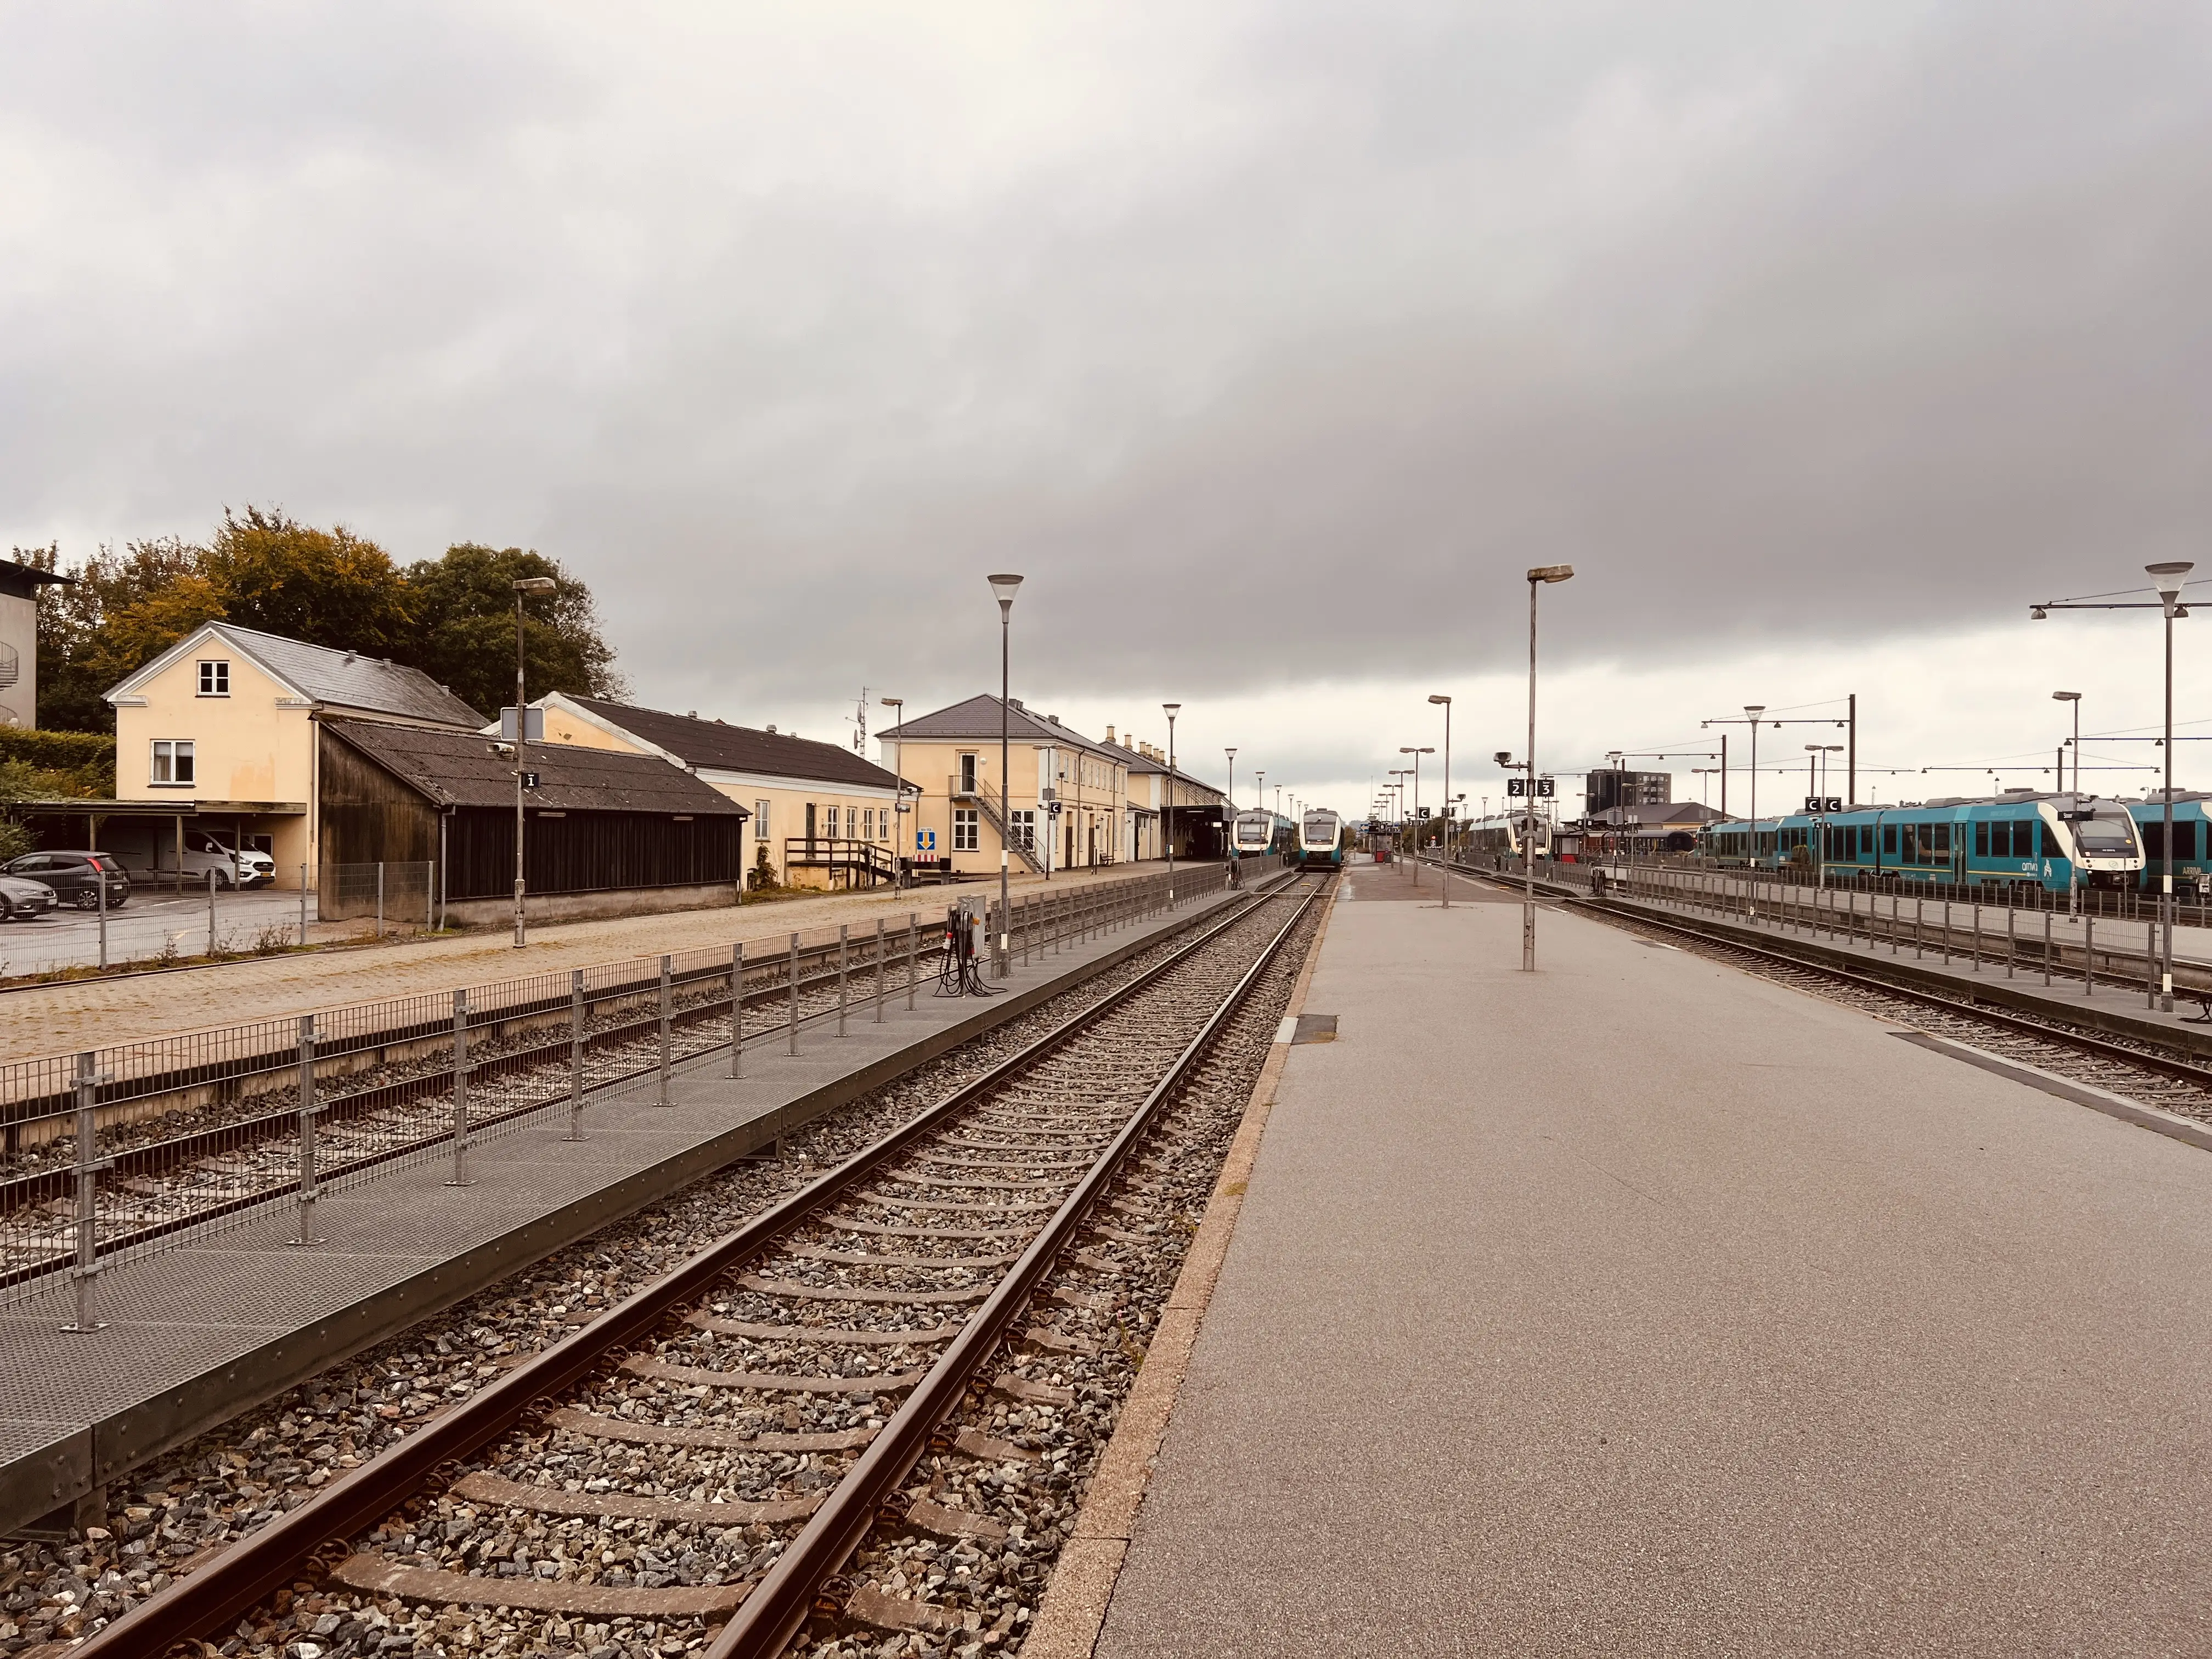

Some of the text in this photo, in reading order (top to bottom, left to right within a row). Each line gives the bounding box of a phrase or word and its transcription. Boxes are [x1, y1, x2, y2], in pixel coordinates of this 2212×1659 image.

[528, 777, 534, 786] 1
[1512, 784, 1520, 794] 2
[1542, 785, 1550, 795] 3
[1809, 800, 1817, 810] C
[1830, 801, 1837, 810] C
[2022, 860, 2038, 871] arriva
[2183, 867, 2202, 875] ARRIVA
